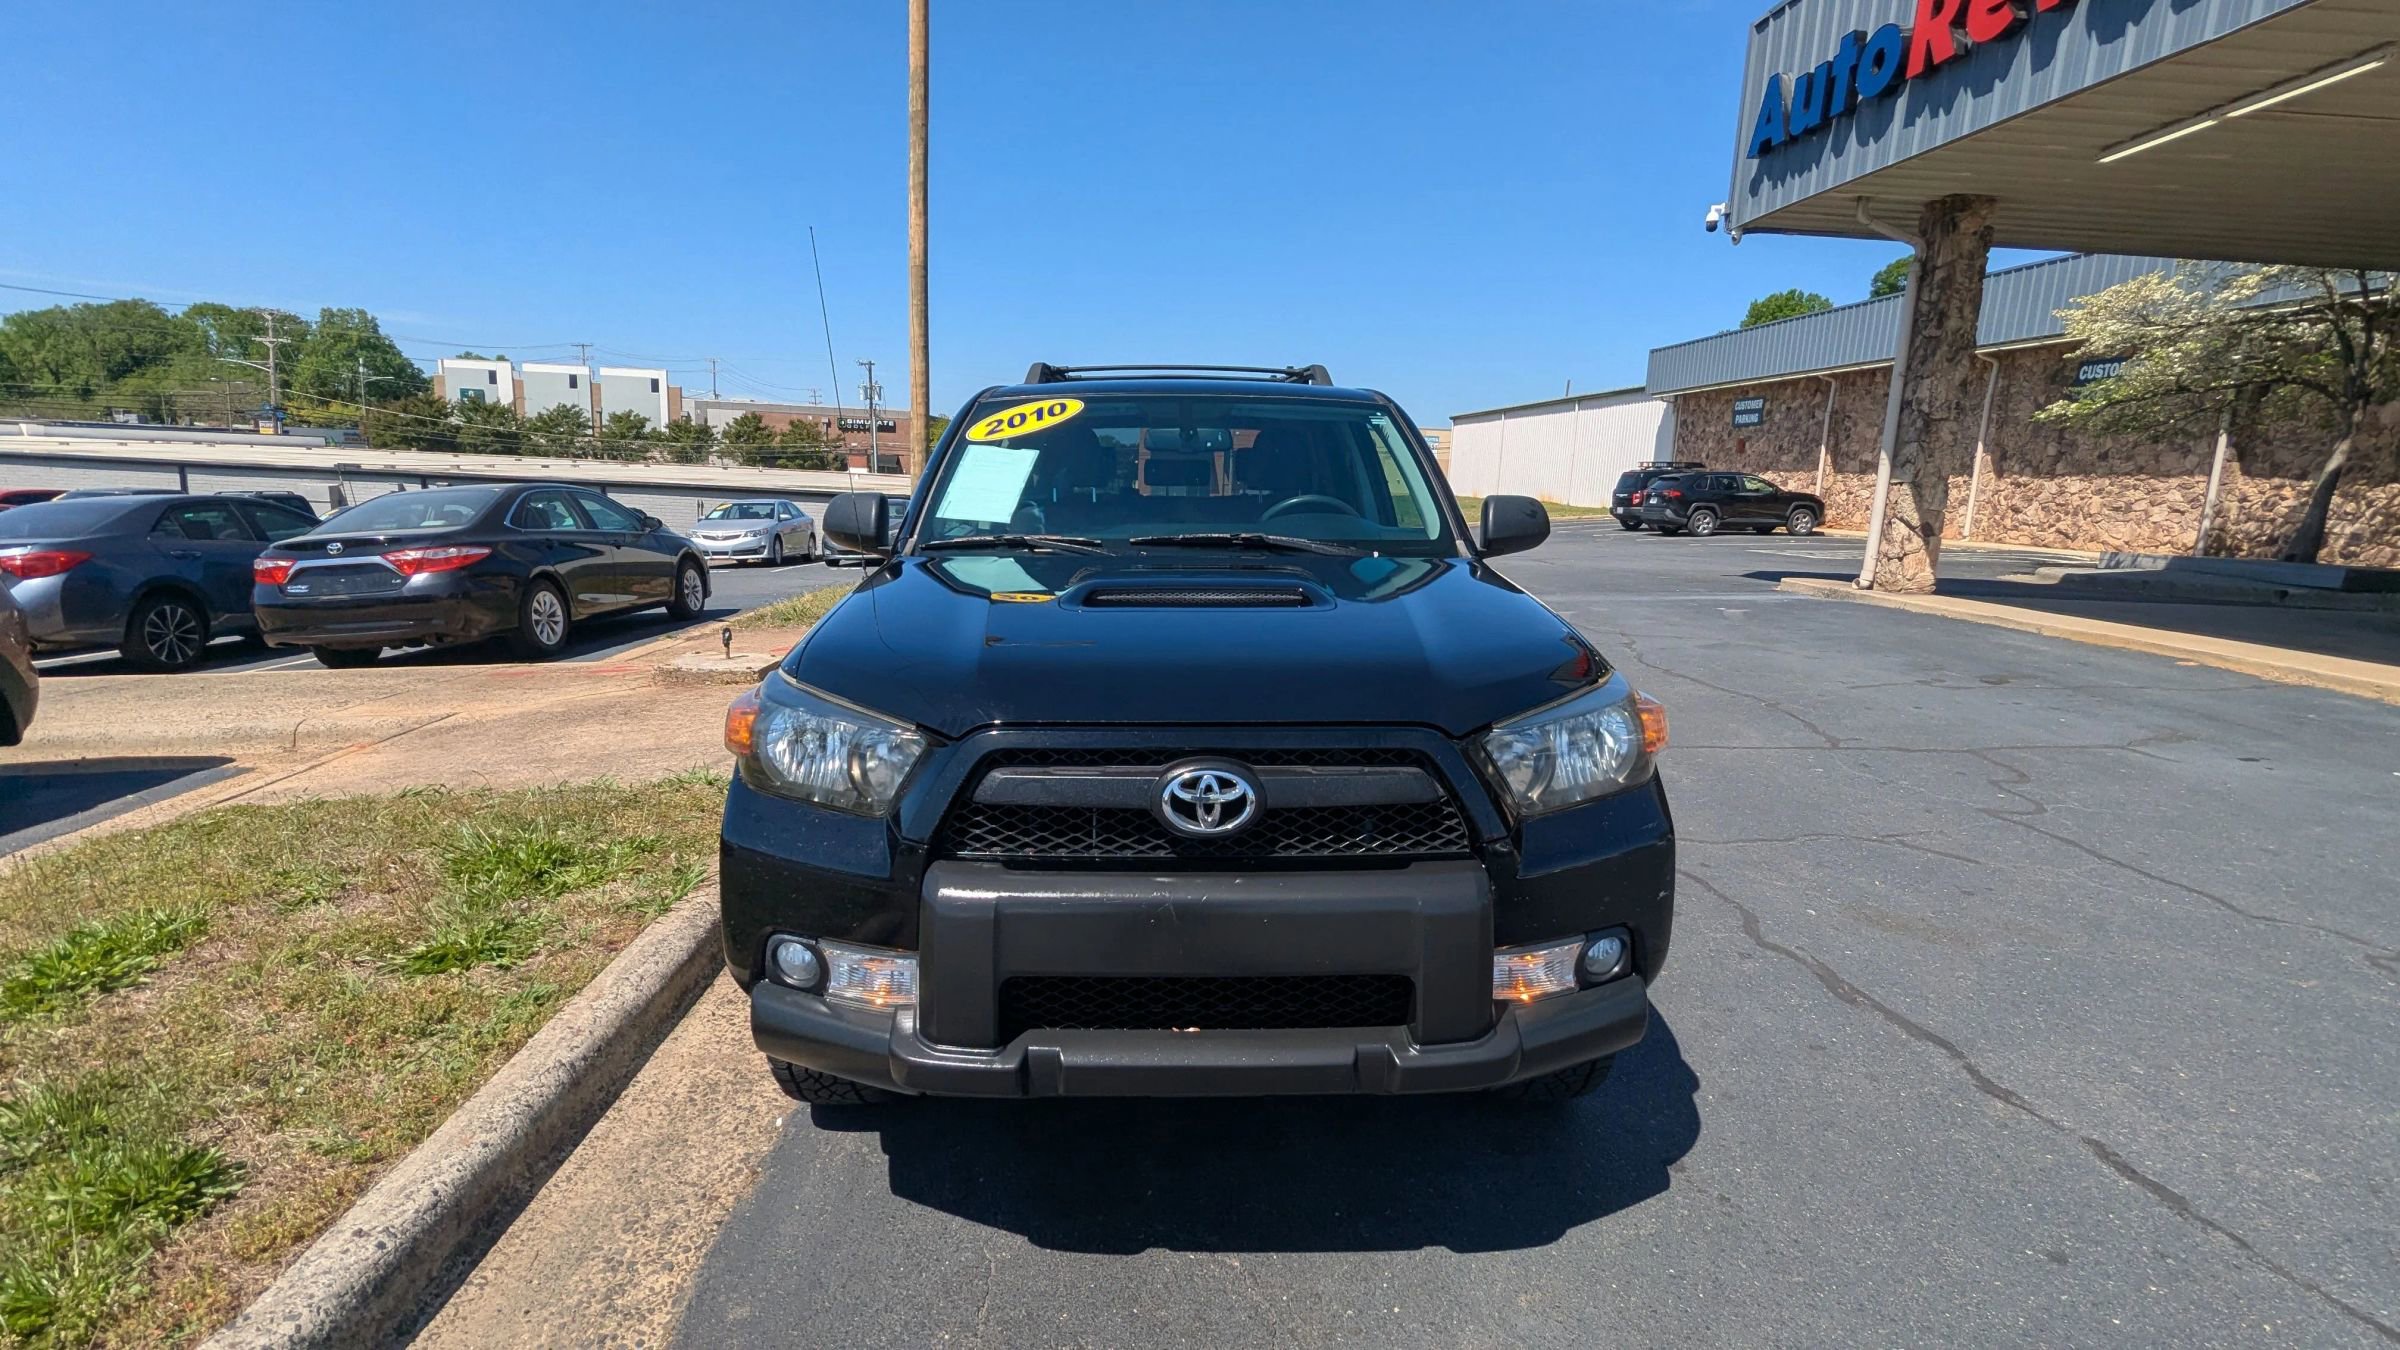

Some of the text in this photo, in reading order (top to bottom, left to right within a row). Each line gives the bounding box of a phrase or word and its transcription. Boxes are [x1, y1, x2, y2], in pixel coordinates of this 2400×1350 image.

[1746, 0, 2066, 159] AutoRe
[1735, 399, 1763, 410] CUSTOMER
[984, 402, 1067, 438] 2010
[1735, 413, 1758, 424] PARKING
